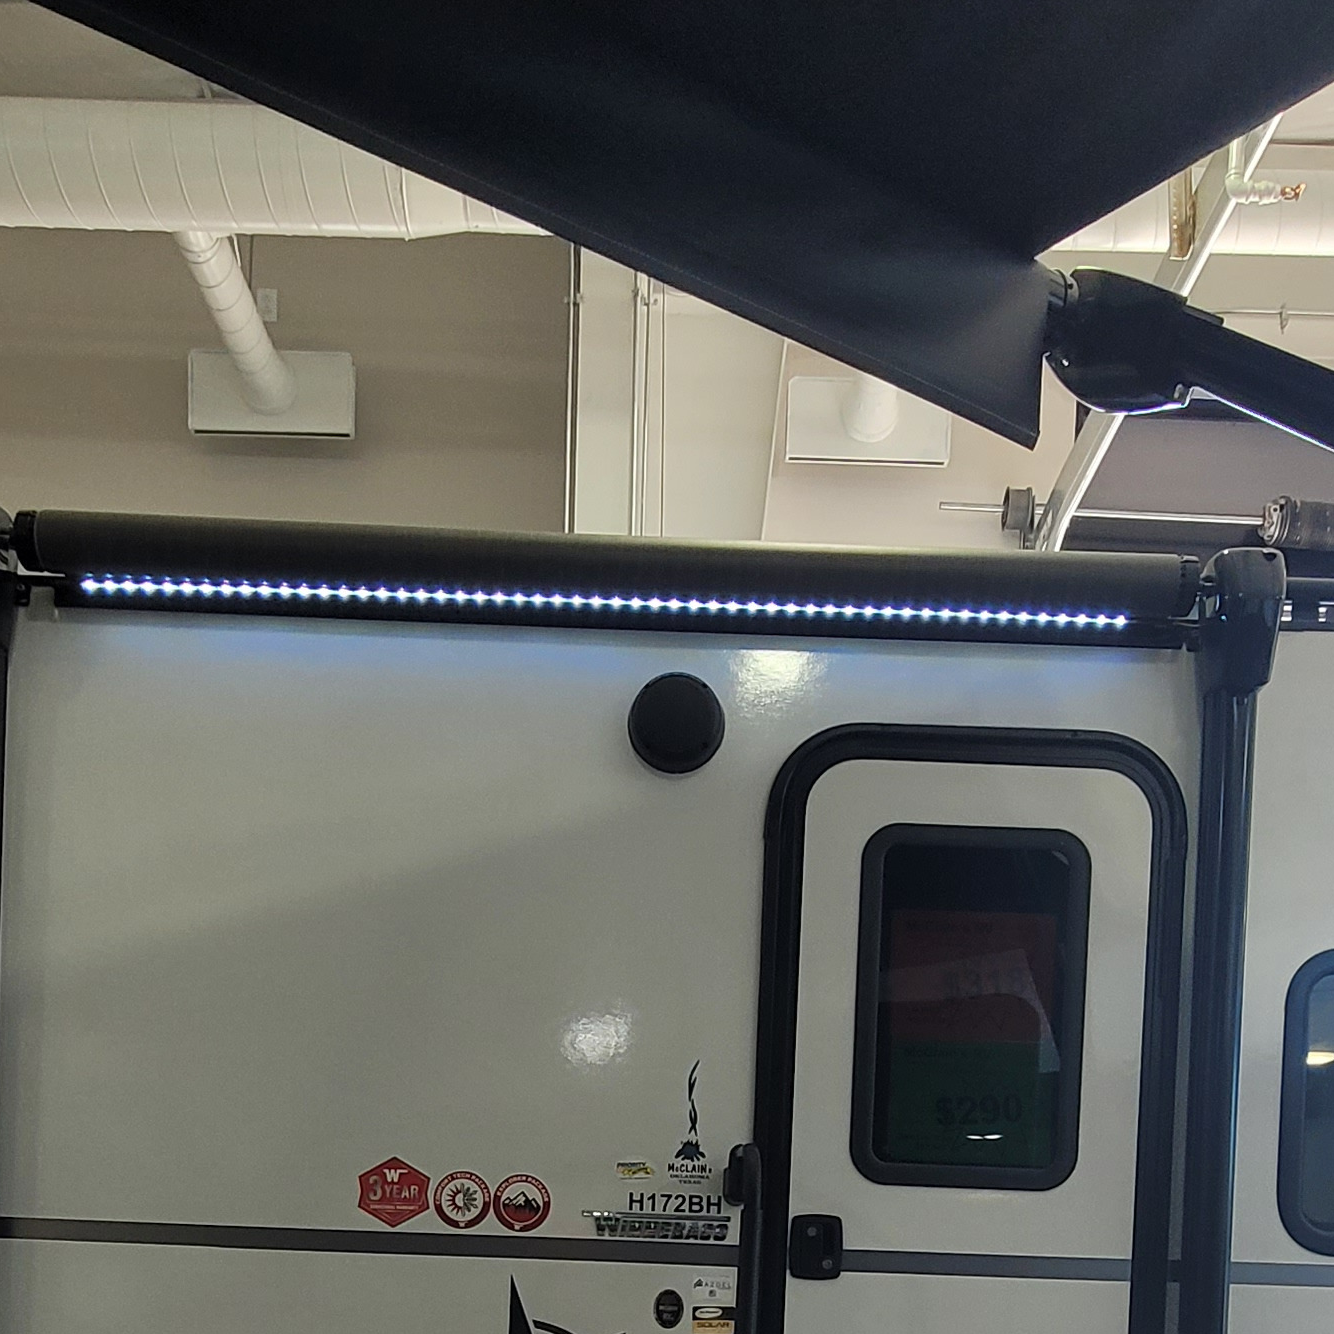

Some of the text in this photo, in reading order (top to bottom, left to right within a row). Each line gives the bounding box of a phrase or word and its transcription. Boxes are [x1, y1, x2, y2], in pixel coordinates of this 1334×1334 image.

[935, 1093, 1023, 1126] $290
[369, 1175, 419, 1200] 3 YEAR
[435, 1175, 452, 1204] COMFORT
[471, 1174, 490, 1202] PACKAGE
[497, 1176, 549, 1202] EXPLORER PACKAGE
[628, 1191, 722, 1215] H172BH
